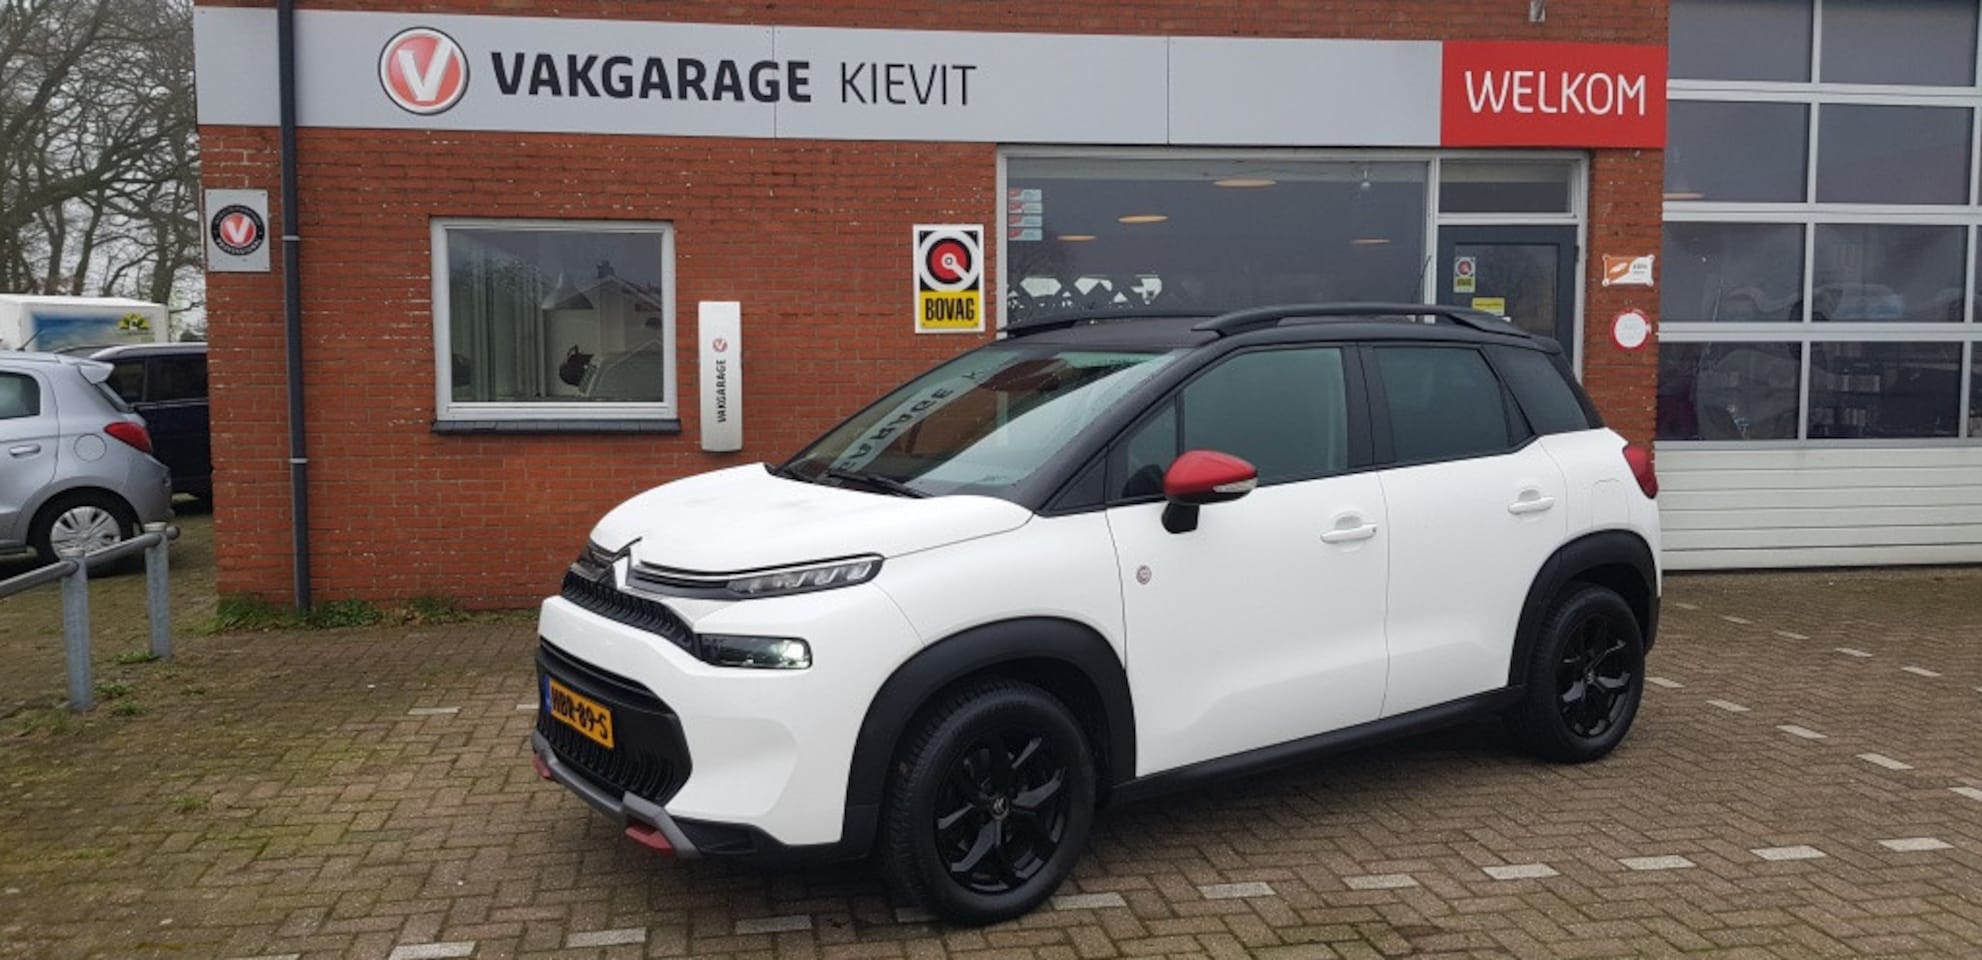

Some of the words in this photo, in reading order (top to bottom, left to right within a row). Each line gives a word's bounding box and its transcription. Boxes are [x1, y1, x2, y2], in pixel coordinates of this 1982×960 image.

[396, 36, 453, 101] V
[491, 51, 812, 105] VAKGARAGE
[840, 61, 978, 107] KIEVIT
[1464, 70, 1647, 117] WELKOM
[924, 297, 975, 322] BOVAG
[715, 359, 727, 423] VAKGARAGE
